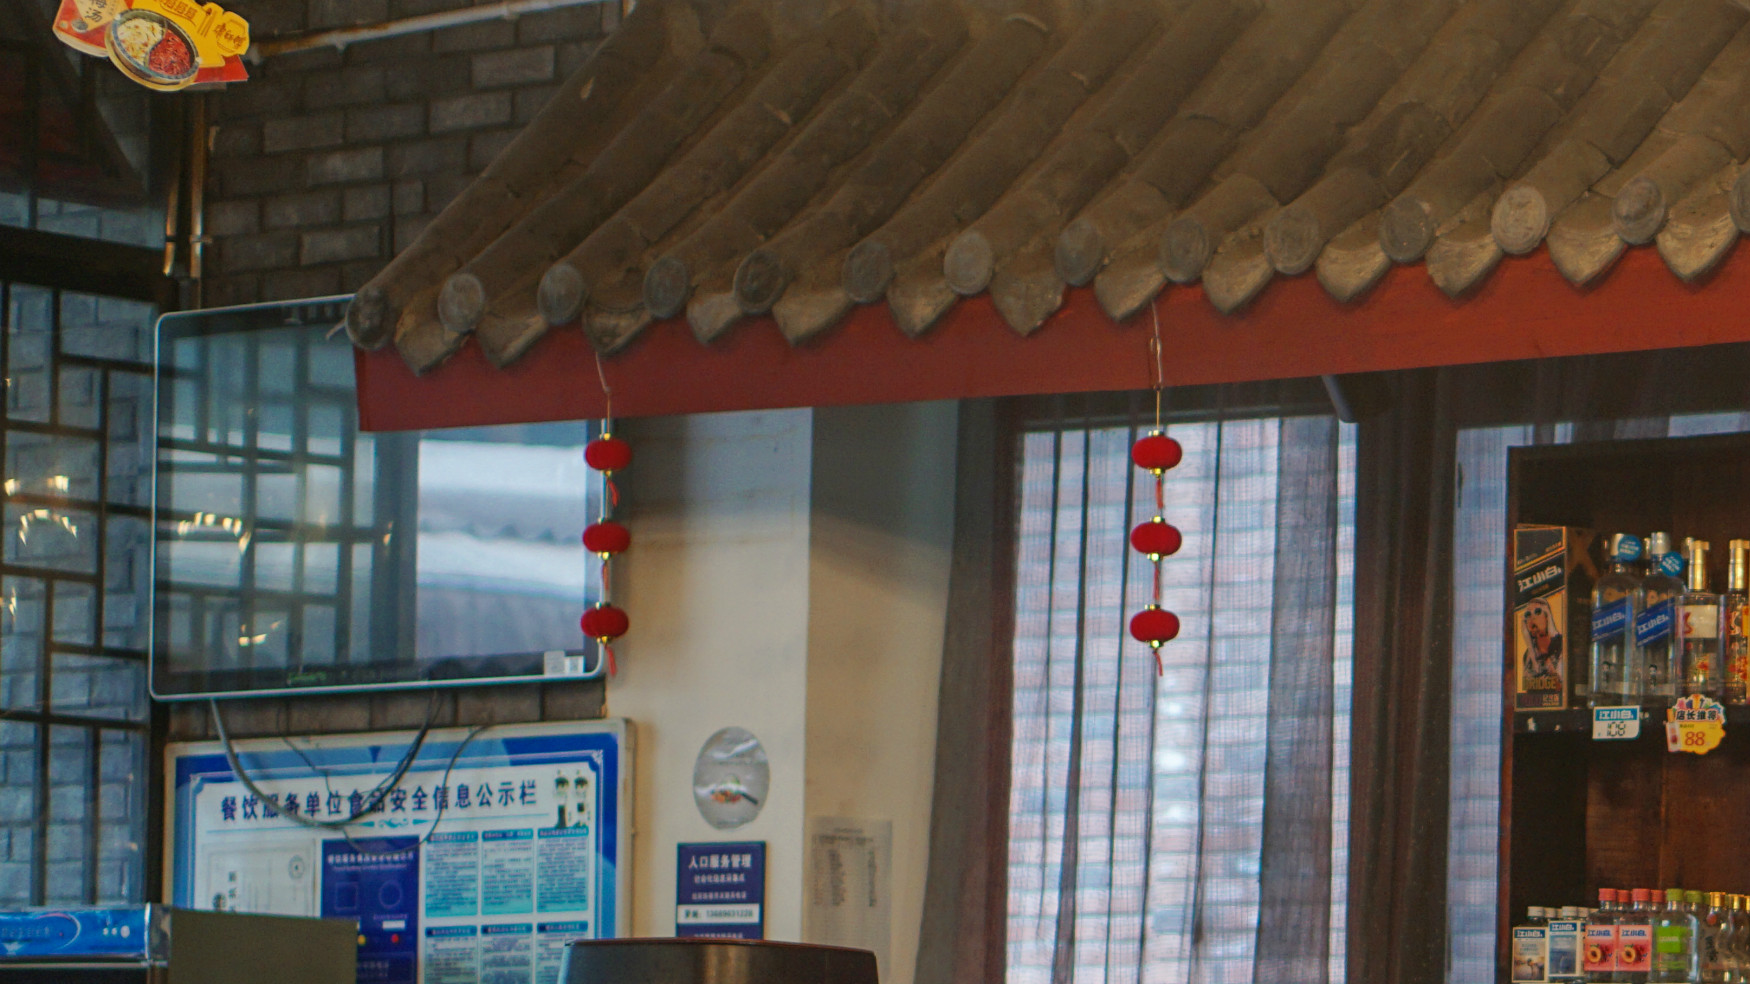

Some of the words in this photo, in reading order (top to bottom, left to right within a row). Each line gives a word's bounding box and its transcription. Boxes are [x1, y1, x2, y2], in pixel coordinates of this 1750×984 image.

[1518, 565, 1562, 593] 江小白
[1599, 709, 1634, 720] 江小白
[1676, 710, 1718, 721] 店长推荐
[1684, 731, 1706, 747] 88
